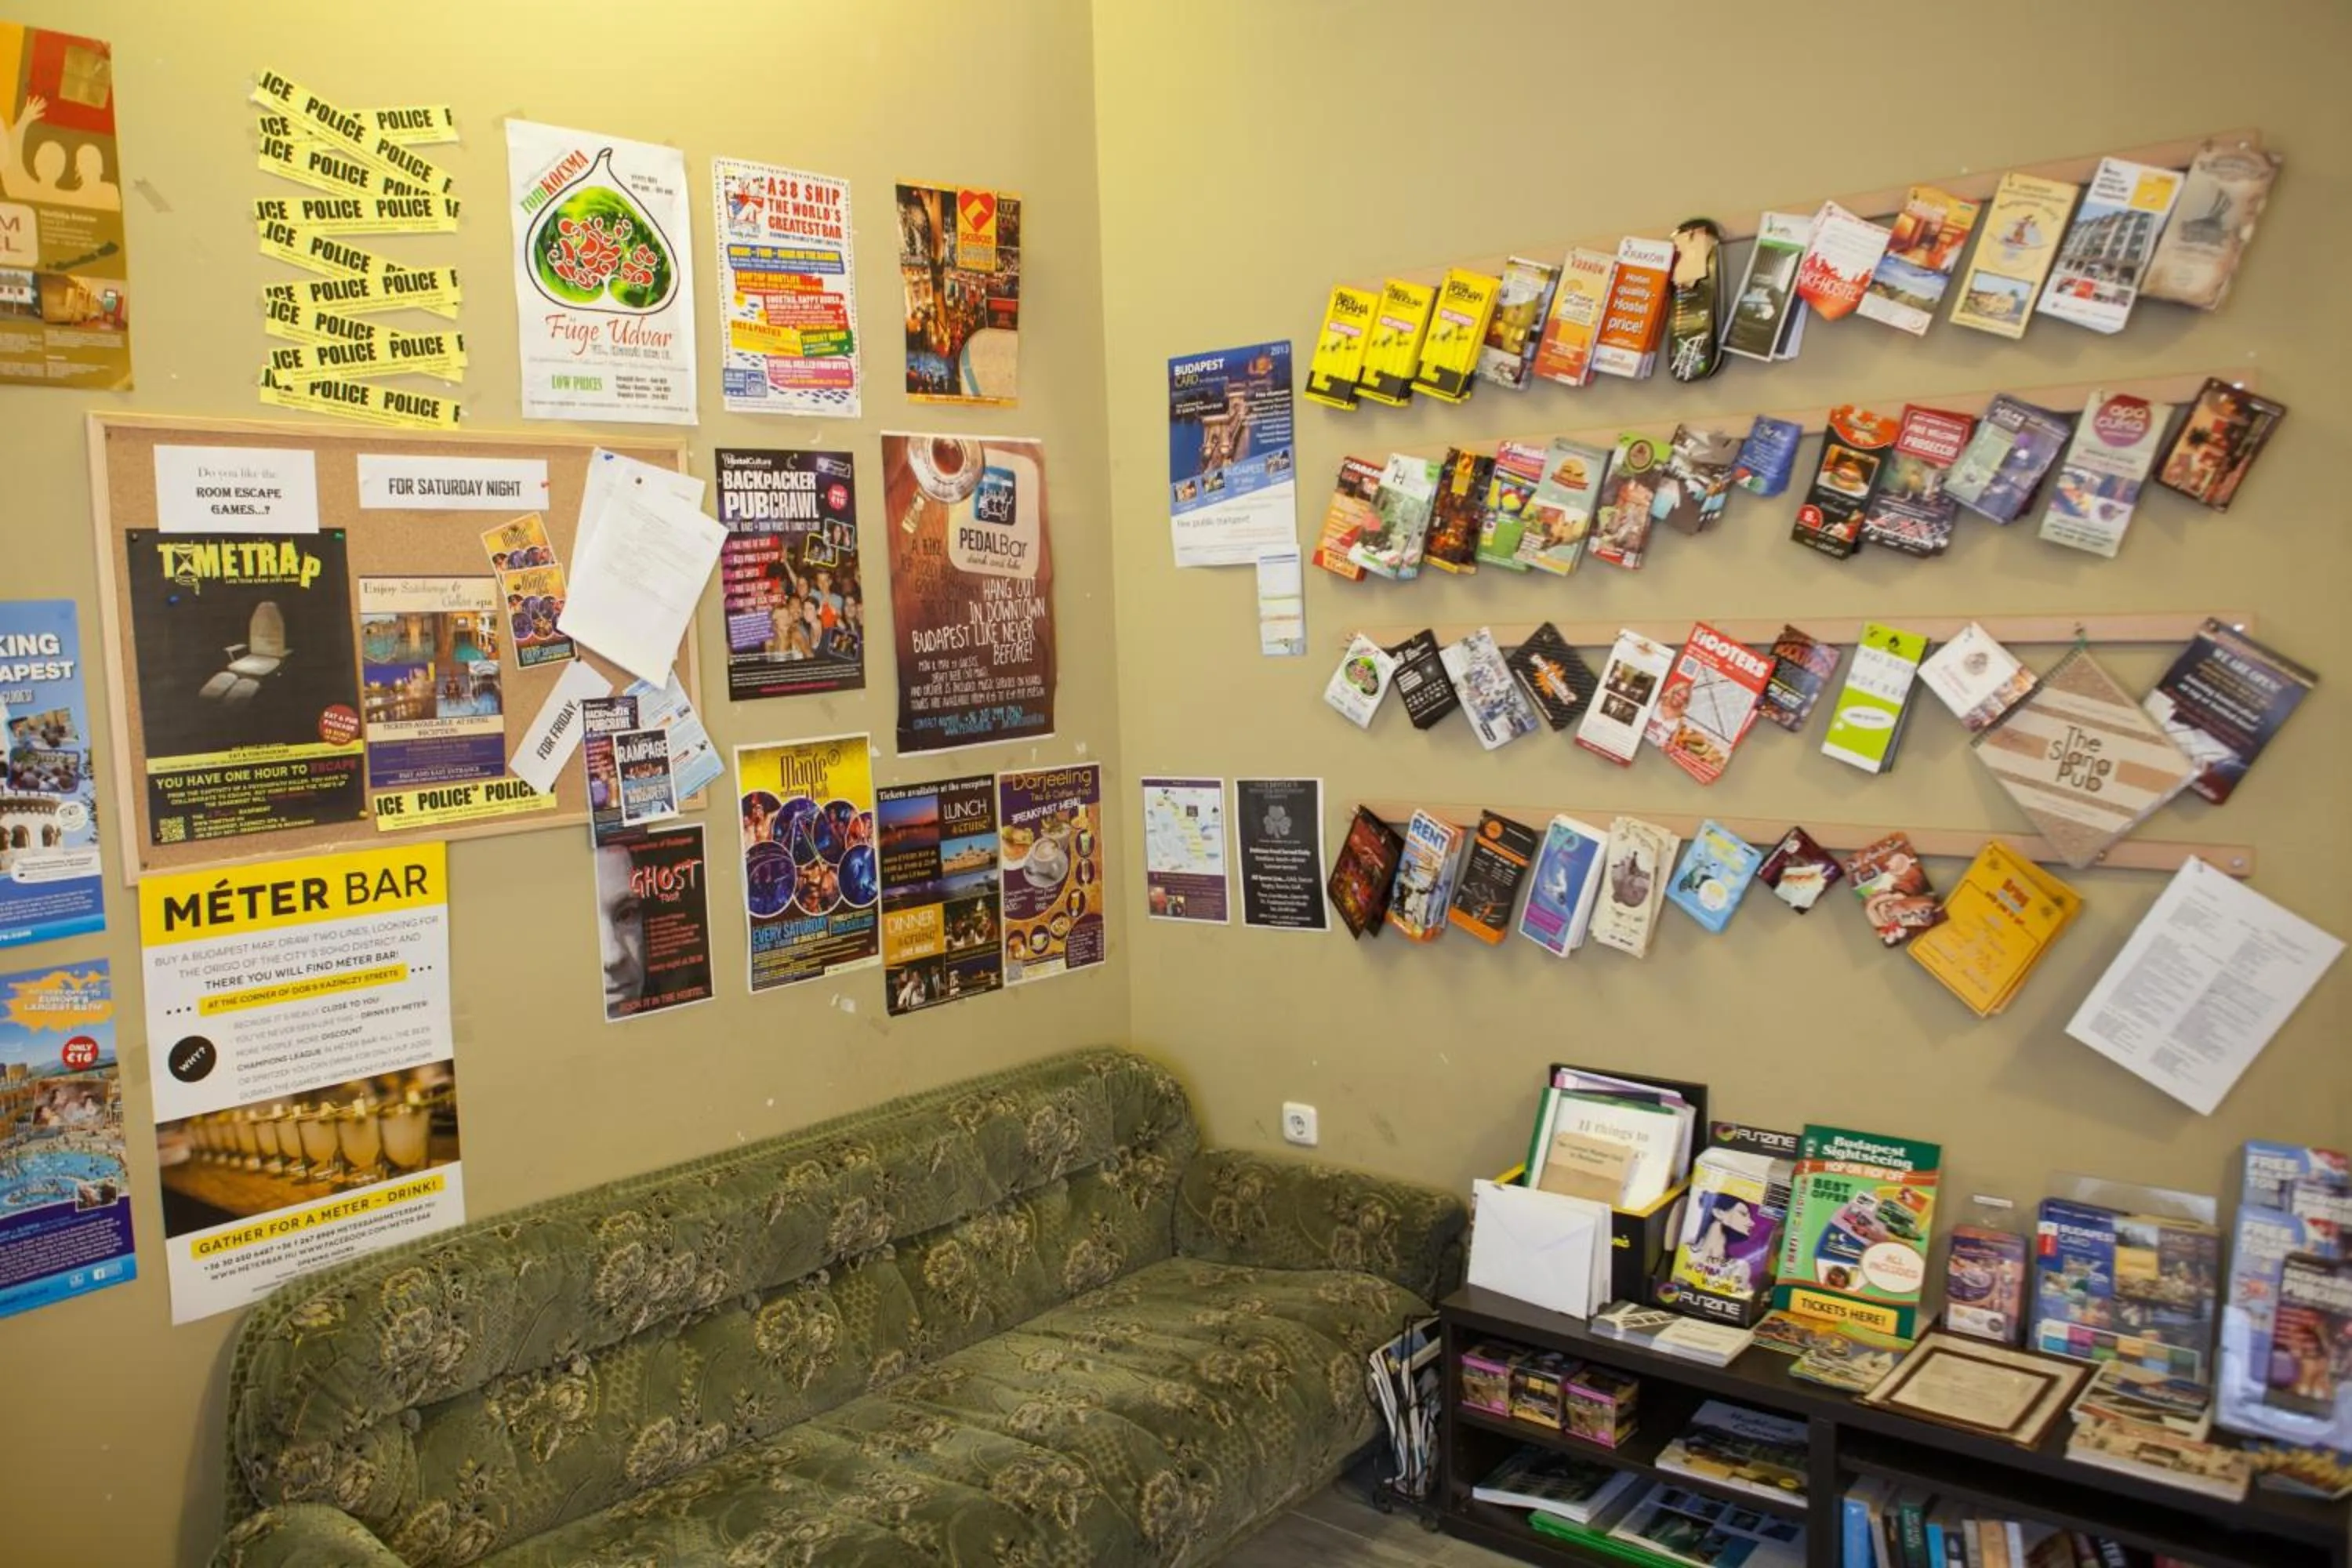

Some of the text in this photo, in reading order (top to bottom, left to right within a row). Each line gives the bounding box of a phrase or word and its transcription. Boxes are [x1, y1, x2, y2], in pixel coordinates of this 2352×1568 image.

[376, 109, 433, 129] POLICE
[305, 96, 433, 183] POLICE POLICE
[309, 151, 369, 188] POLICE
[768, 176, 840, 205] A38 SHIP
[303, 198, 433, 220] POLICE POLICE
[768, 198, 841, 223] THE WORLD'S
[768, 216, 843, 239] GREATEST BAR
[310, 237, 371, 273] POLICE
[310, 271, 438, 302] POLICE POLICE
[545, 314, 600, 356] Füge
[606, 315, 673, 347] Udvar
[1607, 317, 1644, 334] price!
[317, 342, 376, 366] POLICE
[390, 336, 445, 358] POLICE
[1174, 358, 1225, 376] BUDAPEST
[384, 391, 440, 419] POLICE
[196, 487, 282, 499] ROOM ESCAPE
[388, 477, 521, 497] FOR SATURDAY NIGHT
[724, 492, 820, 519] PUBCRAWL
[982, 576, 1037, 601] HANG OUT
[968, 597, 1046, 626] IN DOWNTOWN
[912, 624, 970, 653] BUDAPEST
[975, 622, 999, 646] LIKE
[993, 639, 1033, 666] BEFORE!
[1691, 627, 1768, 677] HOOTERS
[536, 739, 556, 761] FOR
[619, 741, 669, 763] RAMPAGE
[2067, 725, 2103, 753] The
[156, 764, 308, 790] YOU HAVE ONE HOUR TO
[1012, 768, 1093, 792] Darjeeling
[2056, 759, 2103, 792] Pub
[417, 788, 474, 811] POLICE
[879, 790, 906, 801] Tickets
[907, 786, 939, 798] available
[943, 798, 988, 821] LUNCH
[1411, 818, 1447, 852] RENT
[629, 859, 703, 899] GHOST
[163, 863, 429, 932] MÉTER BAR
[887, 909, 936, 935] DINNER
[154, 915, 440, 968] BUY A BUDAPEST DRAW TWO LOOKING FOR
[180, 966, 201, 978] THE
[202, 960, 240, 977] ORIGO
[242, 957, 258, 969] OF
[260, 953, 282, 966] THE
[320, 942, 350, 956] SOHO
[352, 935, 399, 952] DISTRICT
[399, 931, 422, 943] AND
[205, 974, 244, 990] THERE
[246, 970, 273, 983] YOU
[274, 964, 305, 979] WILL
[306, 960, 334, 973] FIND
[206, 999, 220, 1009] AT
[221, 996, 238, 1007] THE
[239, 989, 277, 1004] CORNER
[278, 986, 291, 997] OF
[321, 1025, 364, 1041] DISCOUNT
[178, 1046, 207, 1073] WHY?
[1821, 1145, 1915, 1171] Sightseeing
[1833, 1134, 1907, 1158] Budapest
[1810, 1190, 1850, 1204] OFFER
[1813, 1177, 1853, 1194] BEST
[198, 1181, 437, 1254] GATHER FOR A METER DRINK!
[1800, 1297, 1886, 1327] TICKETS HERE!
